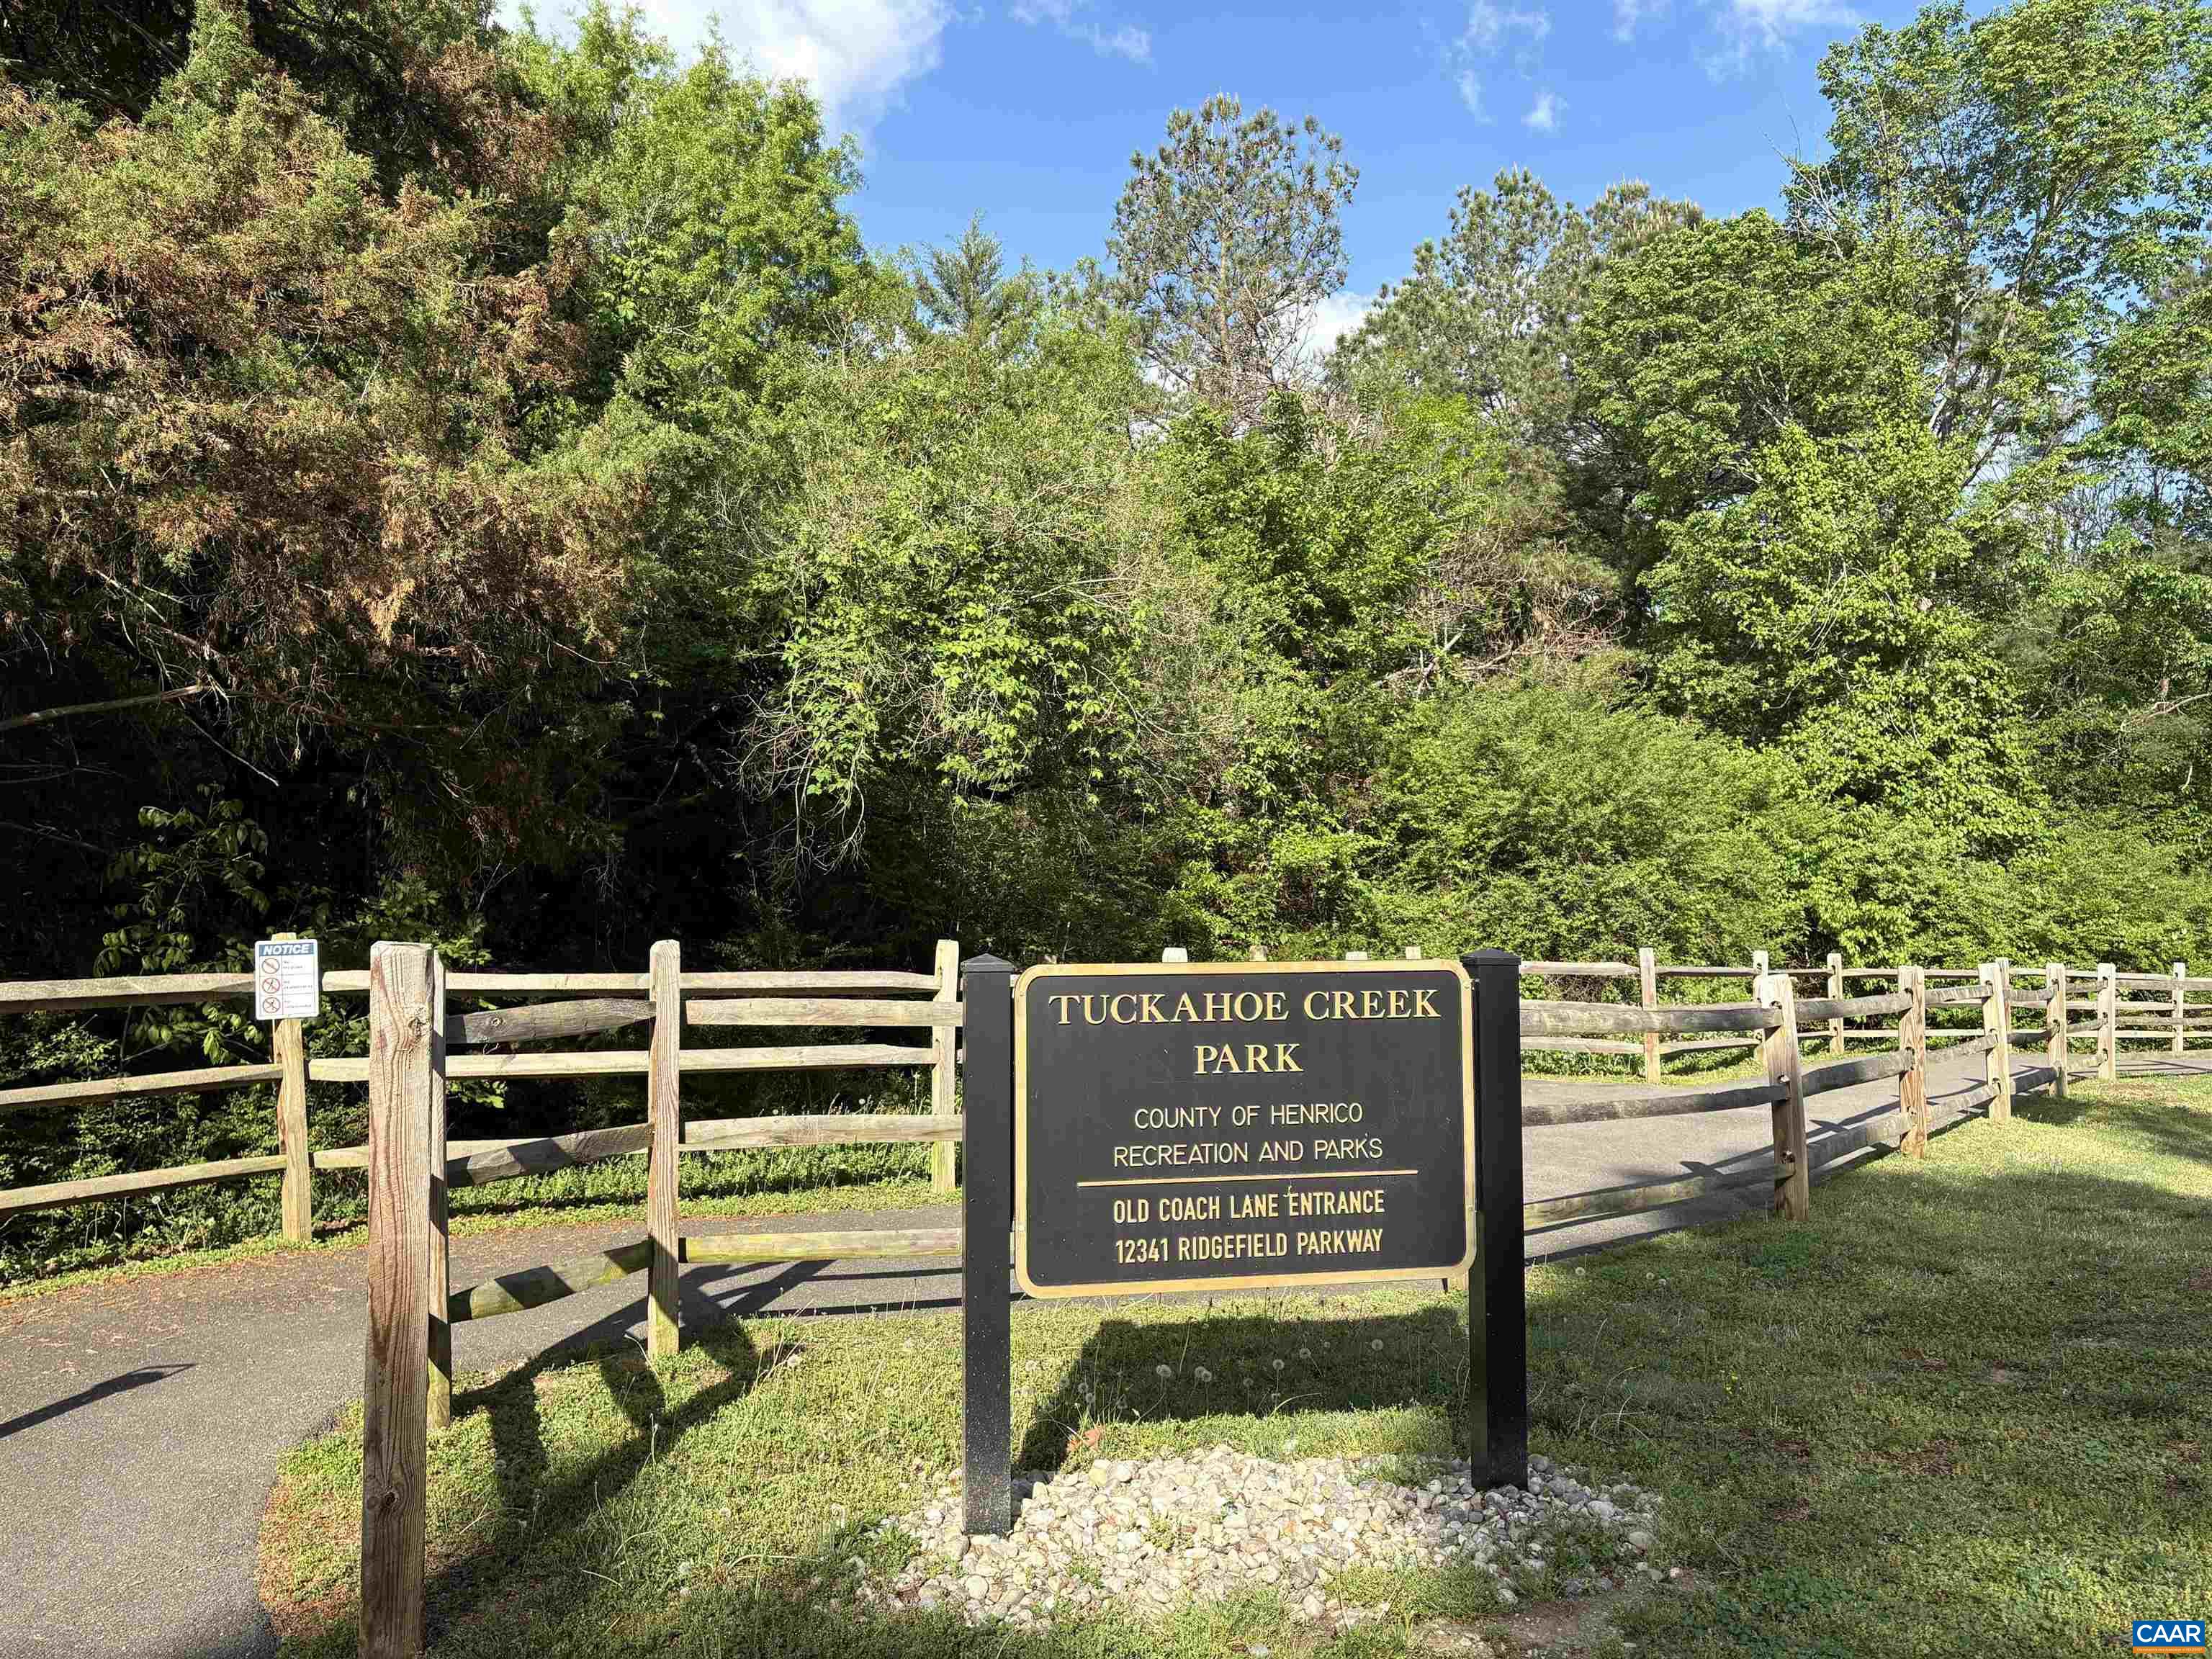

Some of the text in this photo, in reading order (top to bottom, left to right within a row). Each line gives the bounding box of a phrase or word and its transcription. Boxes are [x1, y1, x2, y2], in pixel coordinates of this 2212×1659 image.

[263, 944, 309, 955] NOTICE
[1048, 989, 1442, 1025] TUCKAHOE CREEK
[1193, 1043, 1303, 1074] PARK
[1134, 1102, 1363, 1129] COUNTY OF HENRICO
[1114, 1138, 1383, 1167] RECREATION AND PARKS
[1114, 1190, 1385, 1224] OLD COACH LANE ENTRANCE
[1115, 1228, 1383, 1264] 12341 RIDGEFIELD PARKWAY
